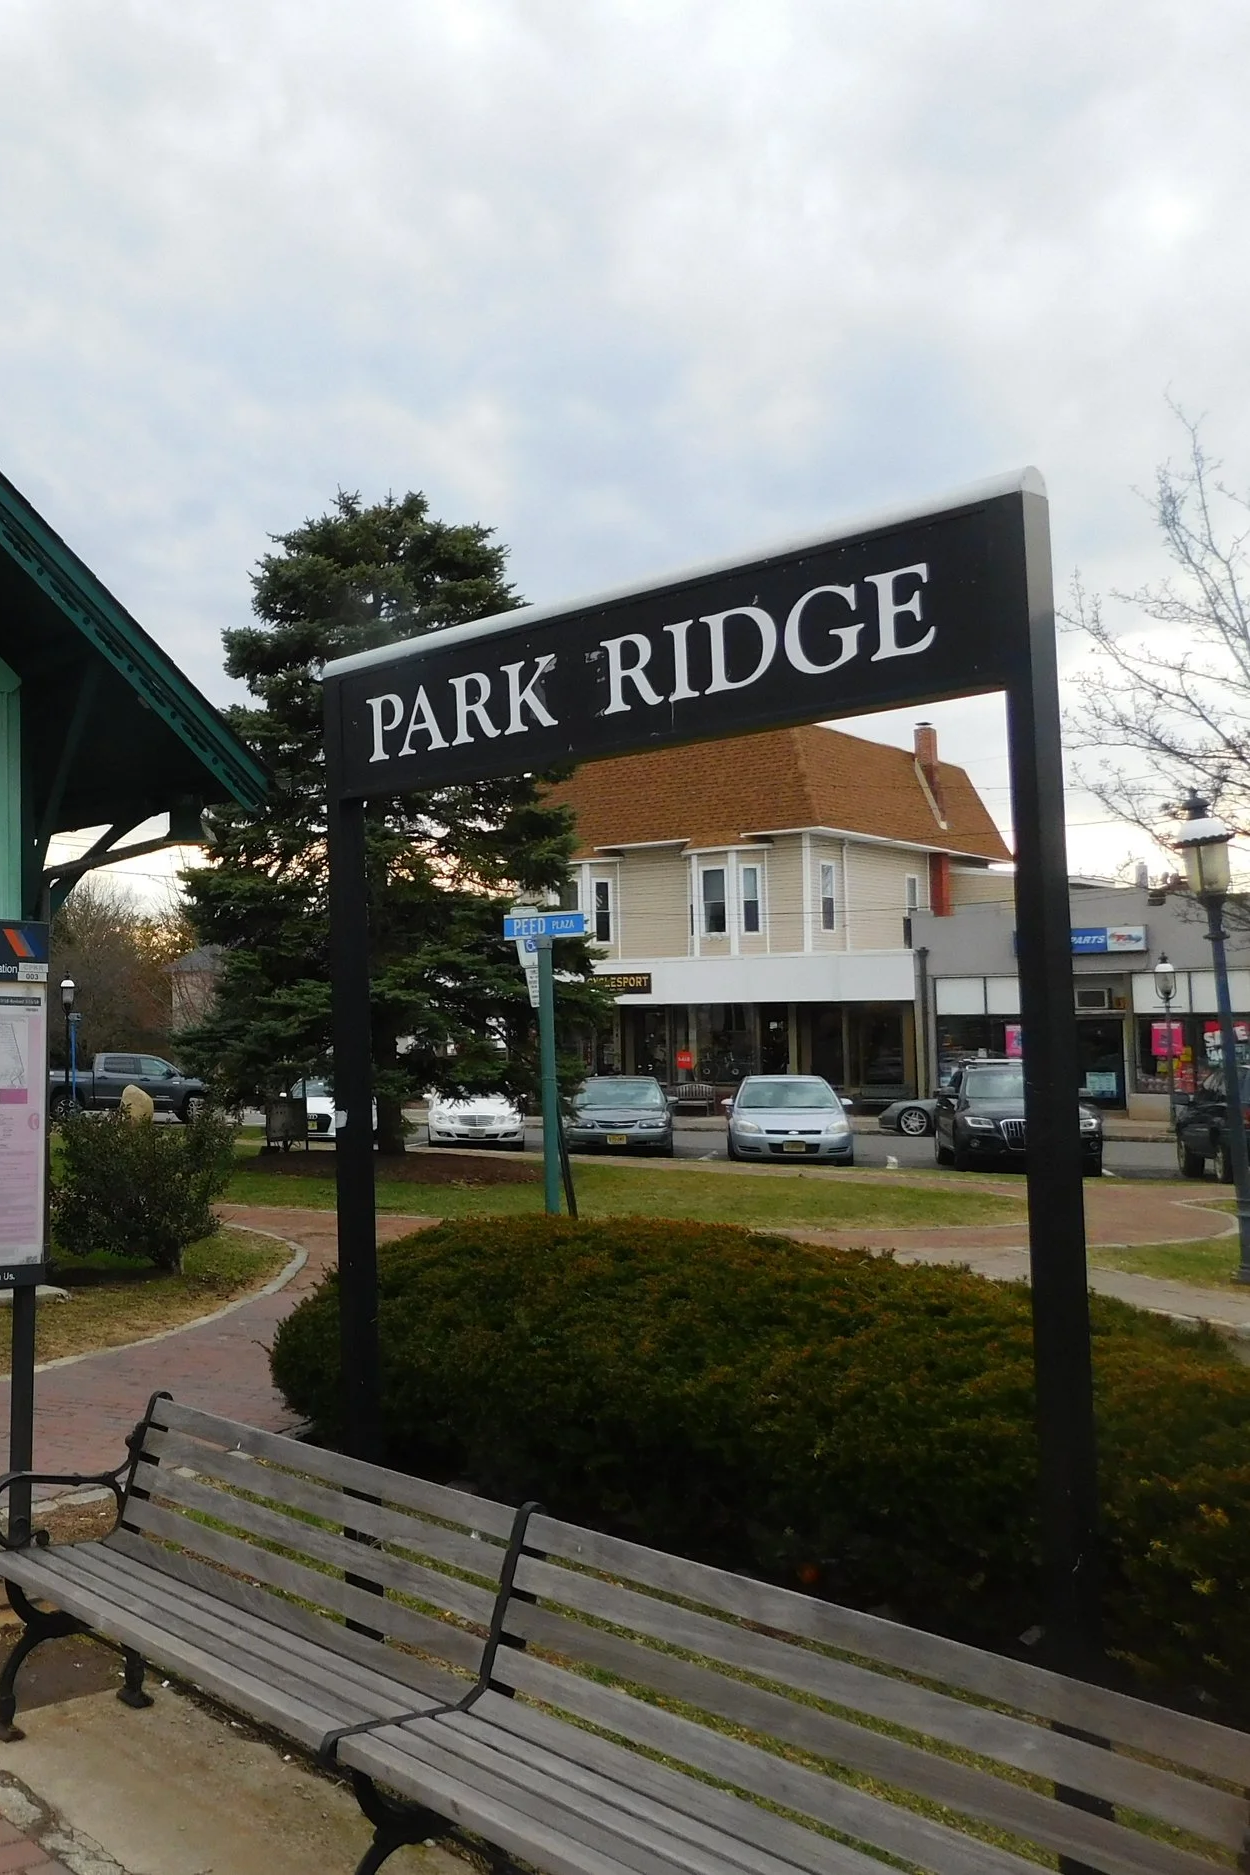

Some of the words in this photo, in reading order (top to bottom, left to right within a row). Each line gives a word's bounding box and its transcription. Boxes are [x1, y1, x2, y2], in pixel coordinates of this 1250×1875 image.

[366, 653, 559, 764] PARK
[601, 562, 937, 716] RIDGE
[513, 917, 546, 936] PEED
[551, 919, 575, 930] PLAZA
[3, 1272, 16, 1281] Us.
